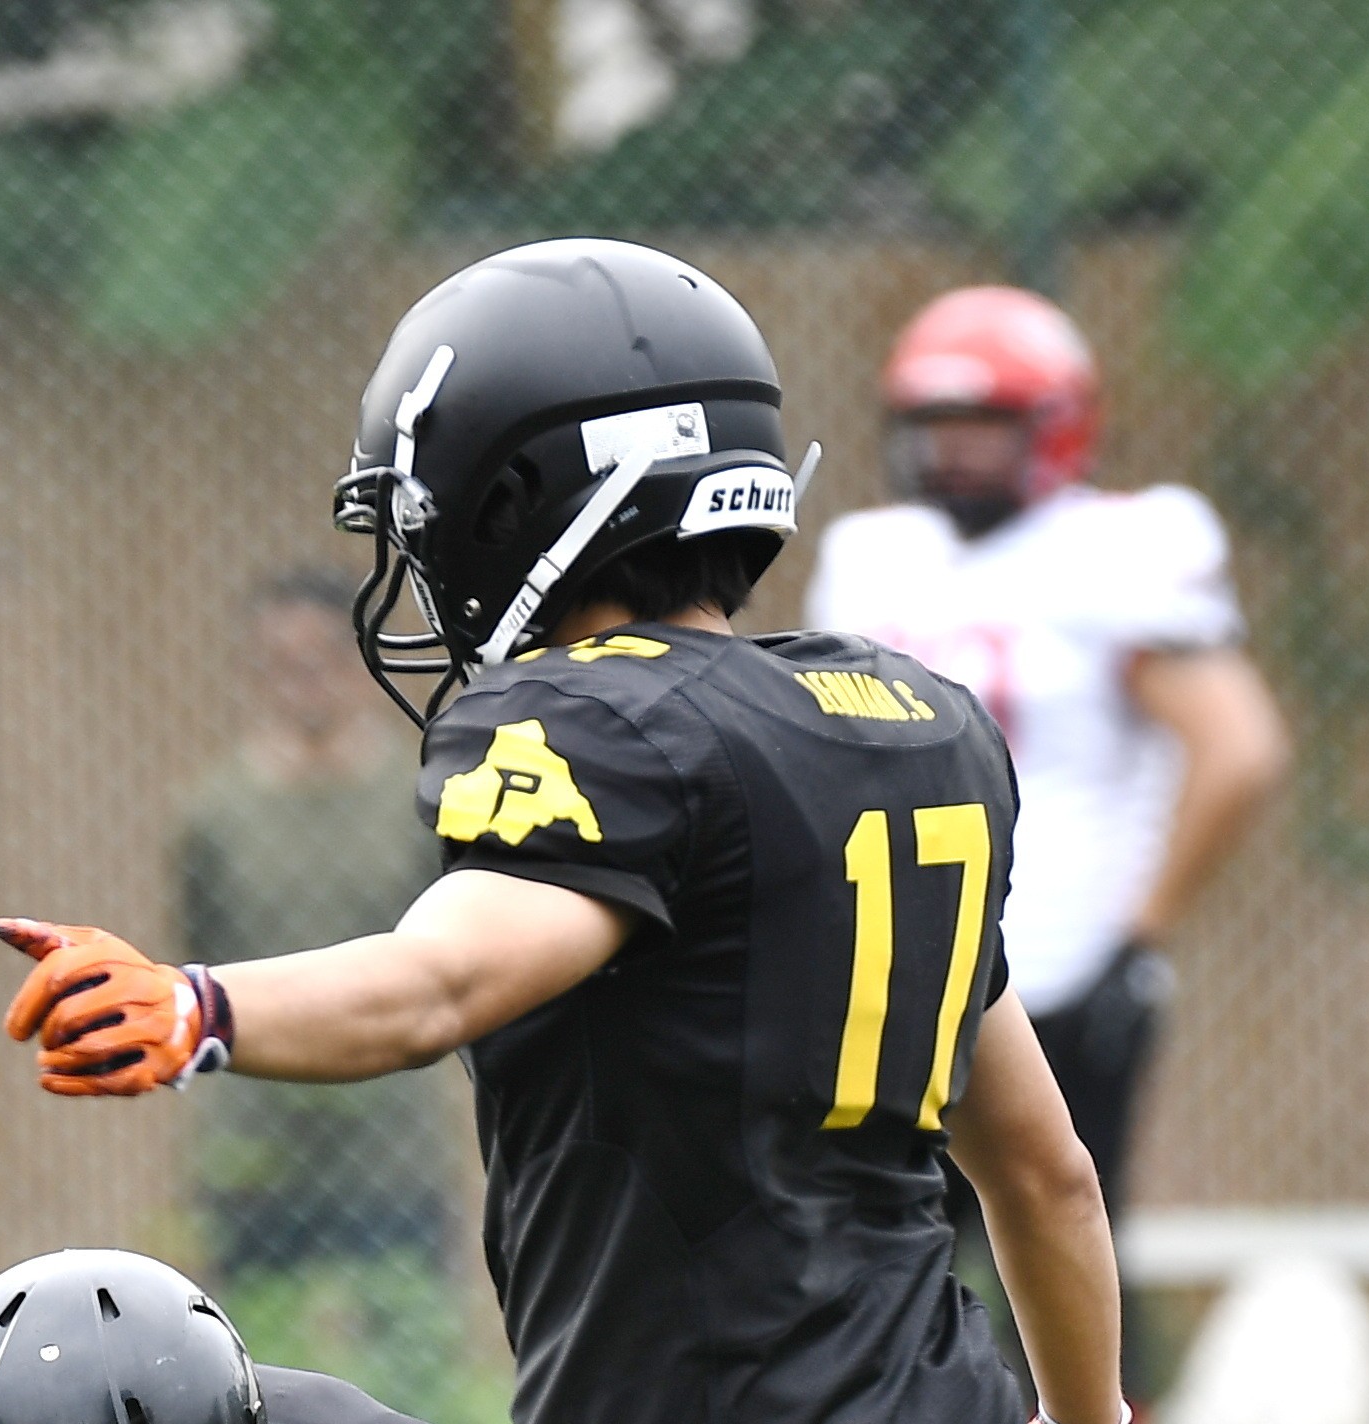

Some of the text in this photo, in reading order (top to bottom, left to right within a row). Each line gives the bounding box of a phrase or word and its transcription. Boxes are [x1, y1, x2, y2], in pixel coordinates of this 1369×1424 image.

[708, 478, 792, 513] schutt
[487, 767, 542, 824] P
[820, 803, 991, 1130] 17
